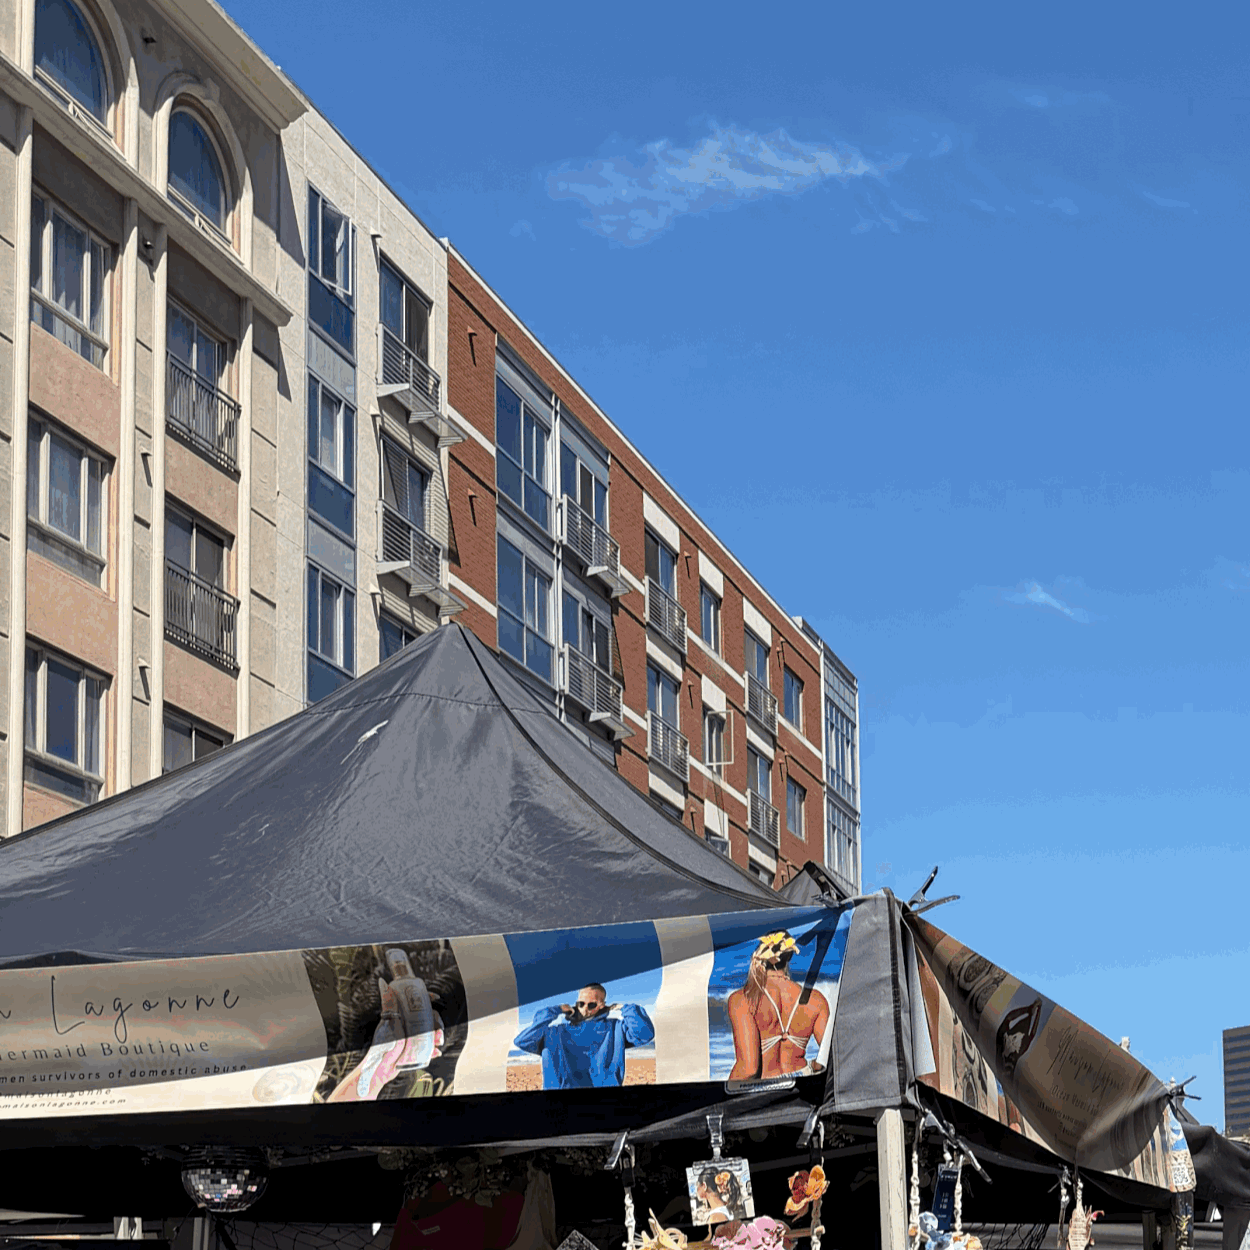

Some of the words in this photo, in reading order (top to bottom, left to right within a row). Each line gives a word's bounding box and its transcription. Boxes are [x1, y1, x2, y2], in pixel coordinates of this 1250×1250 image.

[51, 974, 240, 1044] Lagonne
[0, 1043, 88, 1062] ermaid
[101, 1039, 210, 1056] Boutique
[32, 1070, 101, 1083] survivors
[108, 1068, 122, 1079] of
[130, 1065, 198, 1079] domestic
